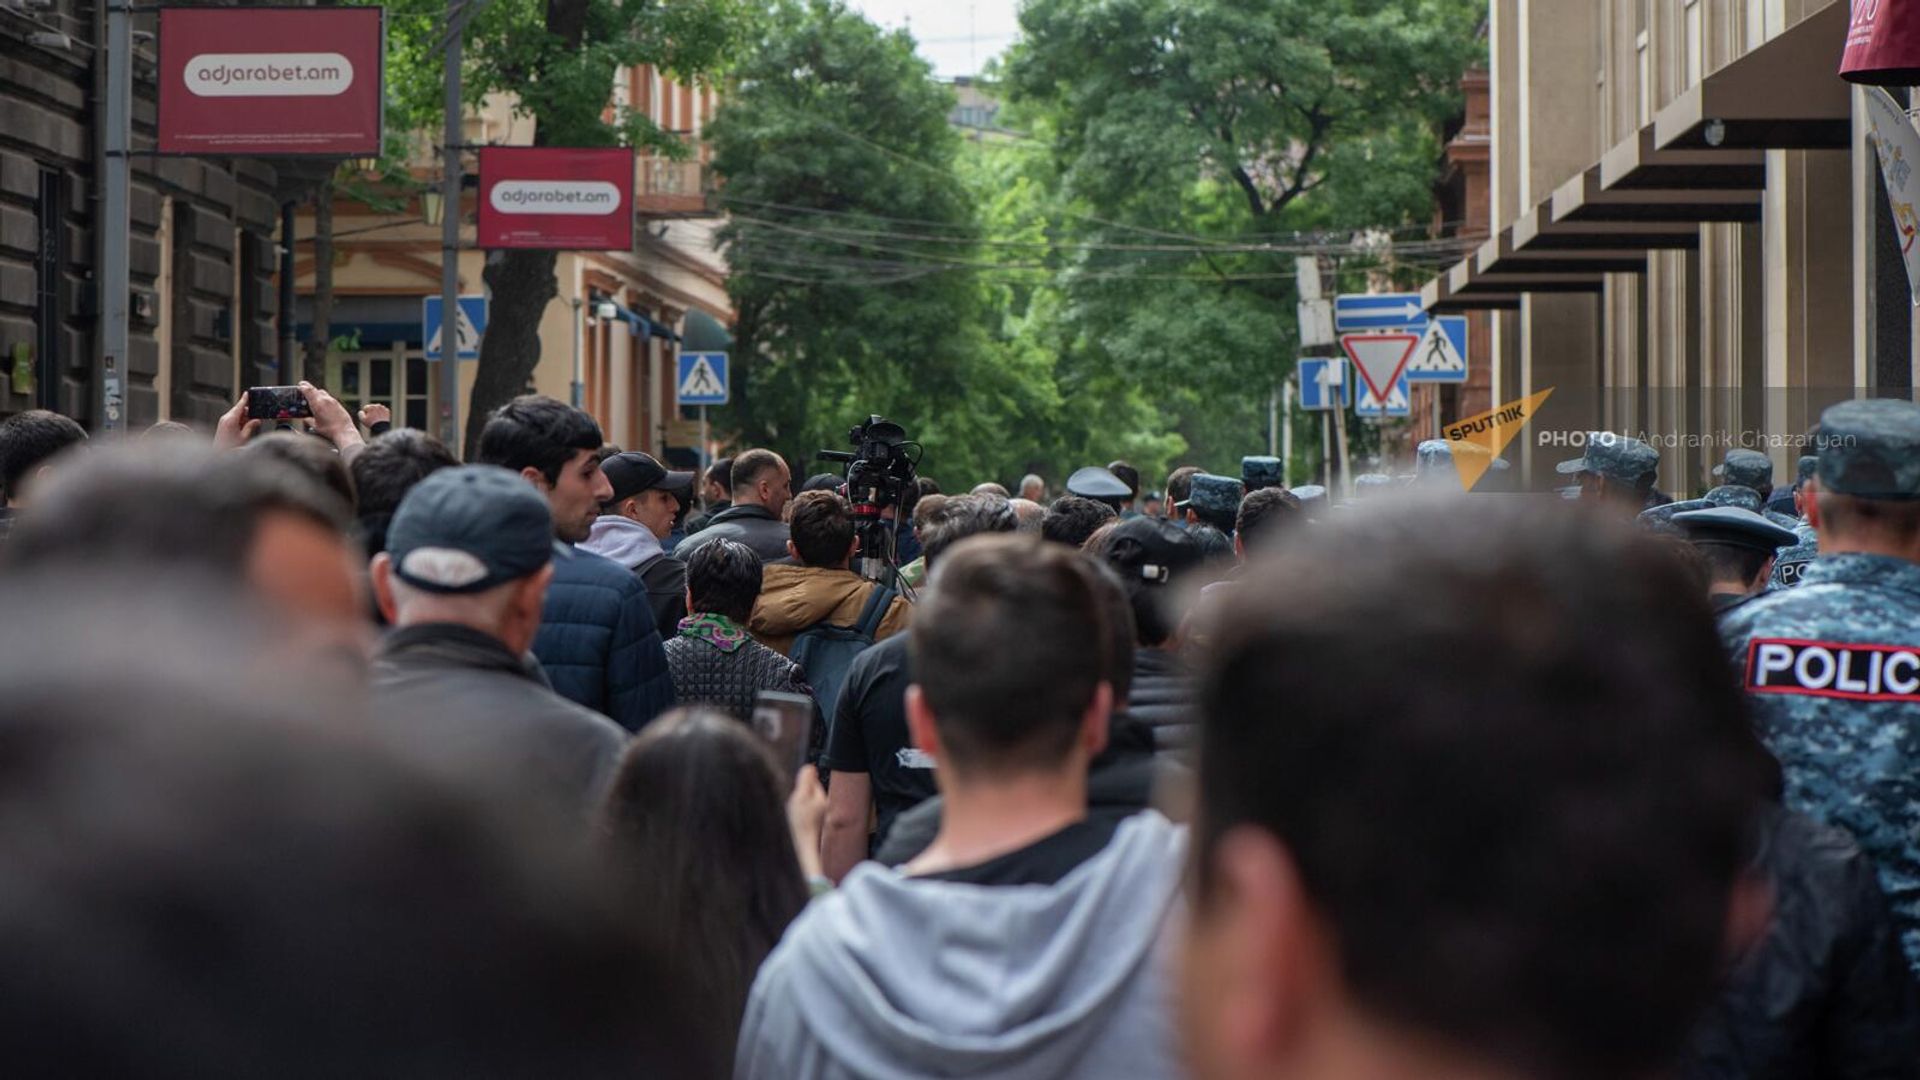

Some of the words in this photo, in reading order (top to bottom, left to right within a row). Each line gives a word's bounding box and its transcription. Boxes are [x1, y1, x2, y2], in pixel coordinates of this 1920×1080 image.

[198, 64, 340, 85] adjarabet.am
[501, 189, 610, 205] adjarabet.am
[1756, 644, 1920, 694] POLIC
